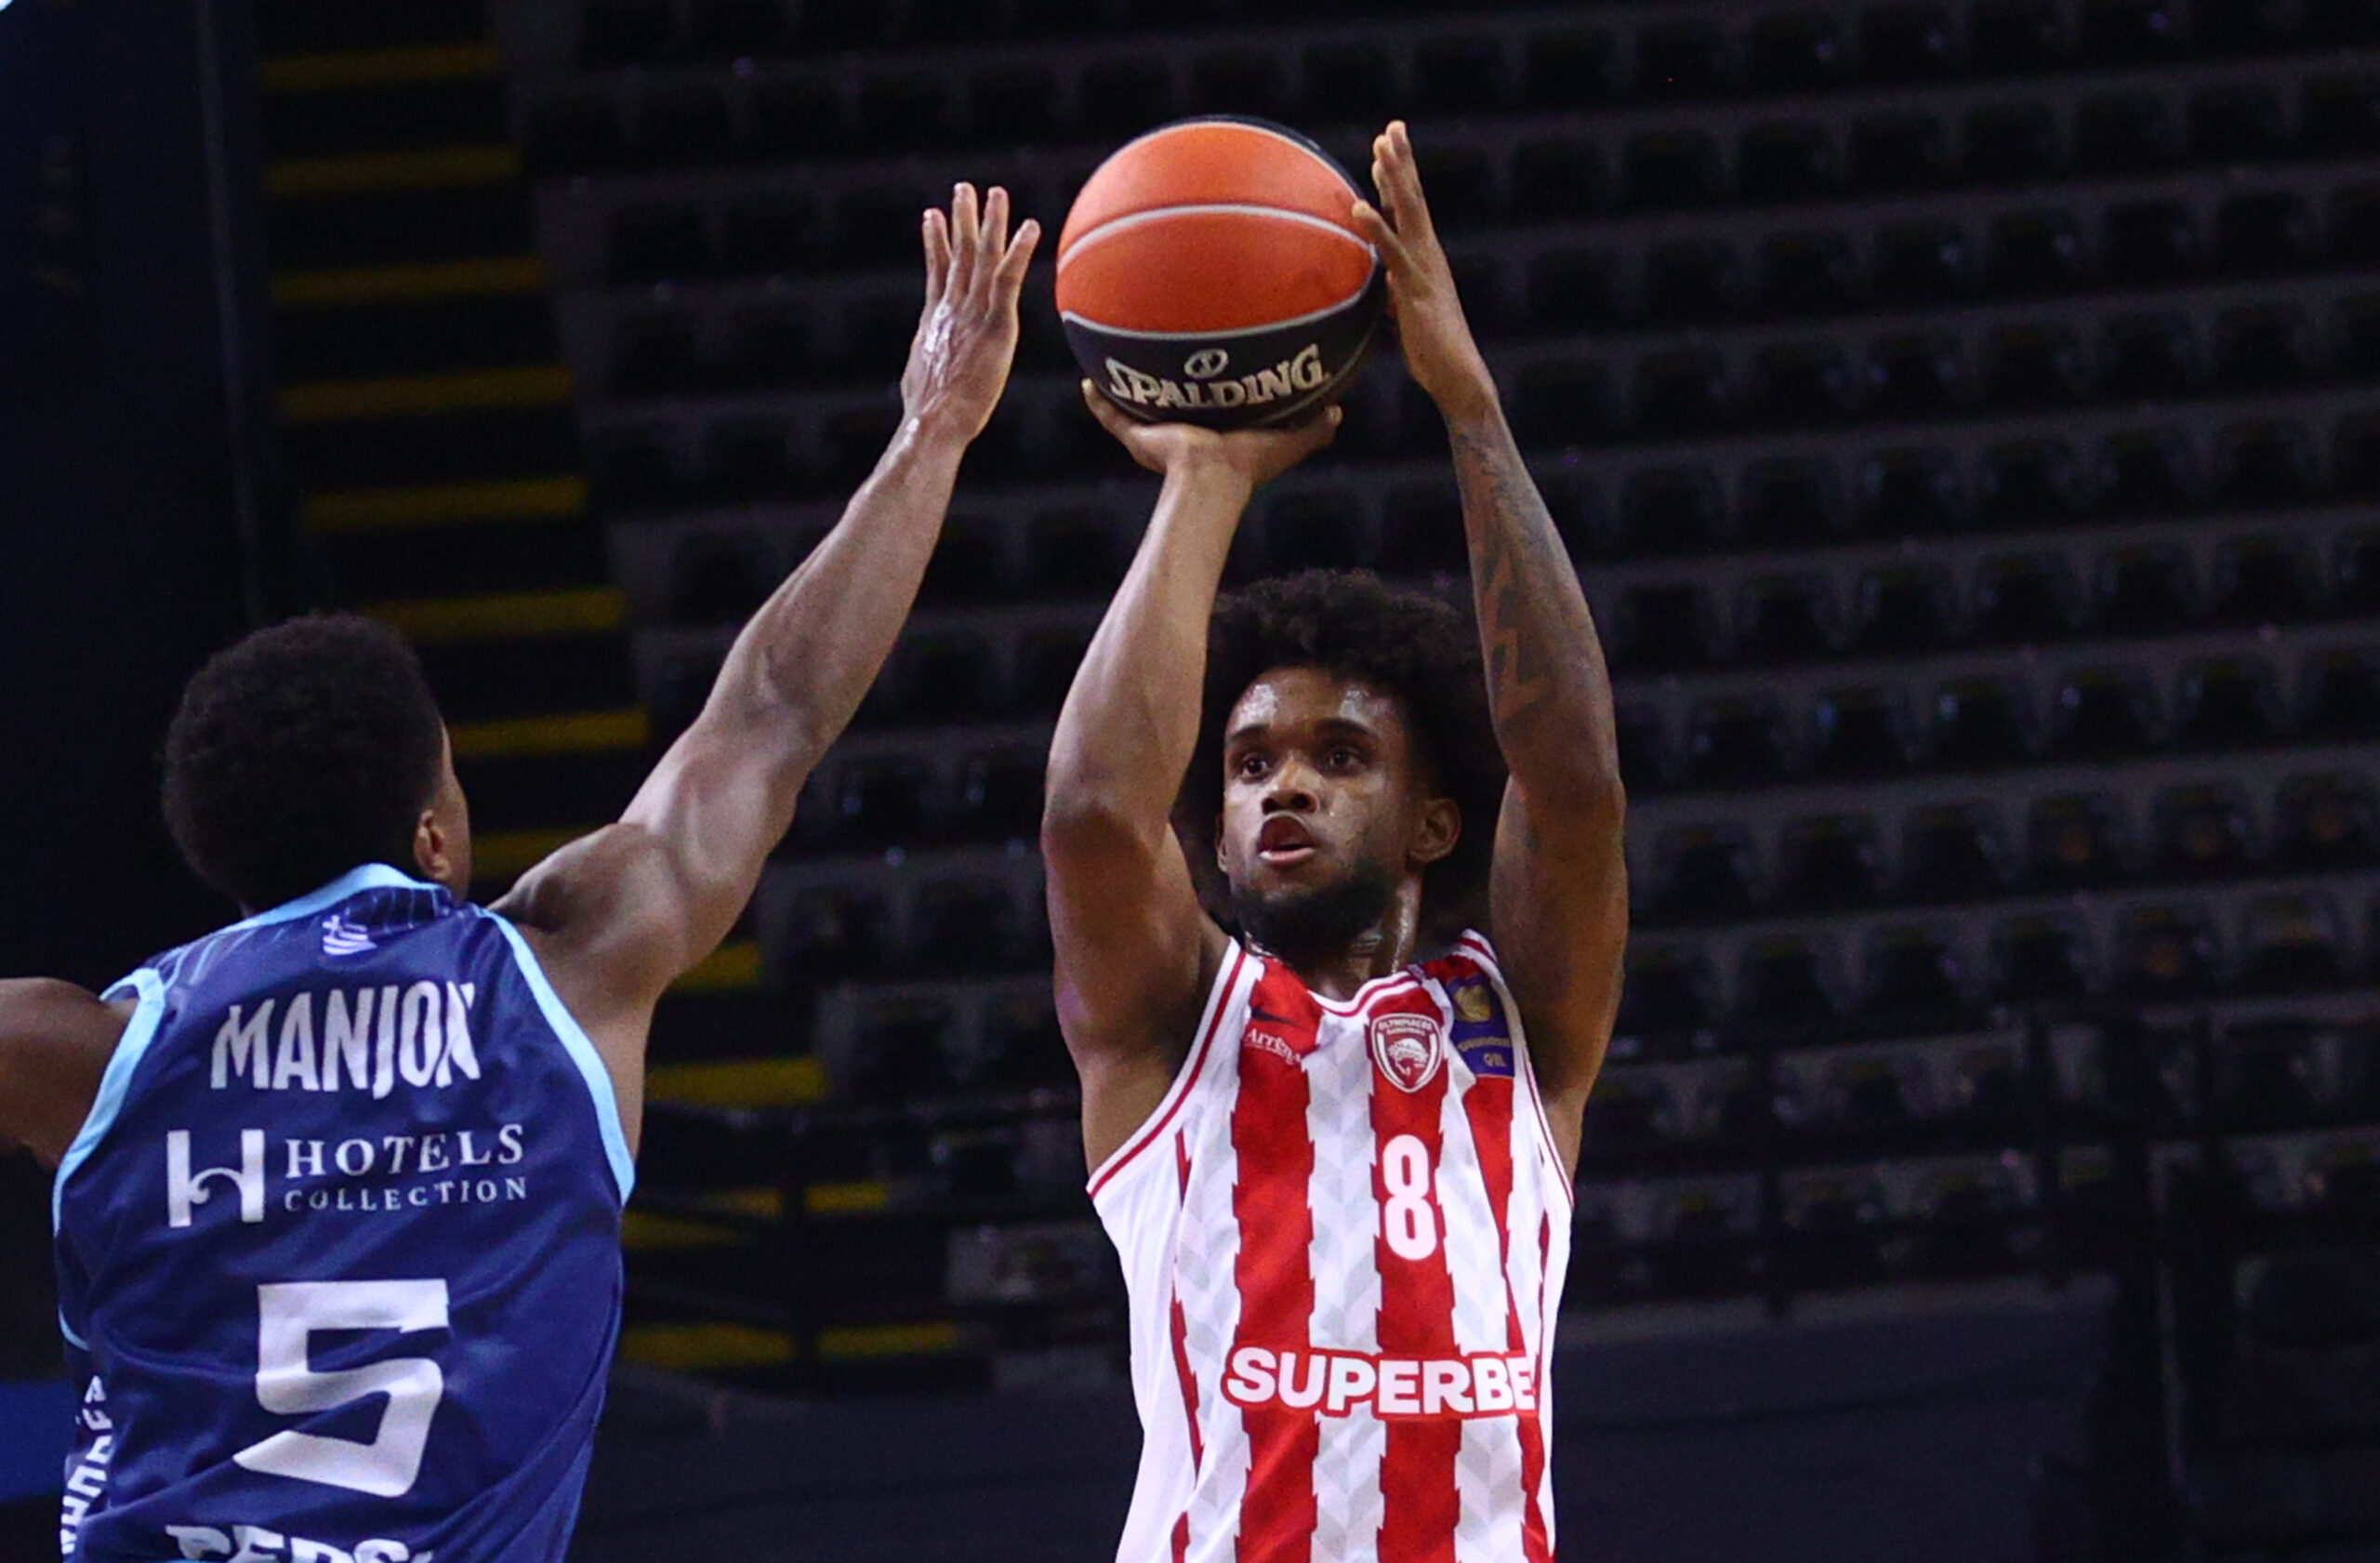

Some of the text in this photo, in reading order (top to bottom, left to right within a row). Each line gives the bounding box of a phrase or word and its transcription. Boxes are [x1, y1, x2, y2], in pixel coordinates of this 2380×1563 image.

[1105, 343, 1326, 409] SPALDING
[284, 1123, 524, 1179] HOTELS
[284, 1176, 528, 1212] COLLECTION
[1382, 1133, 1438, 1261] 8
[233, 1278, 450, 1498] 5
